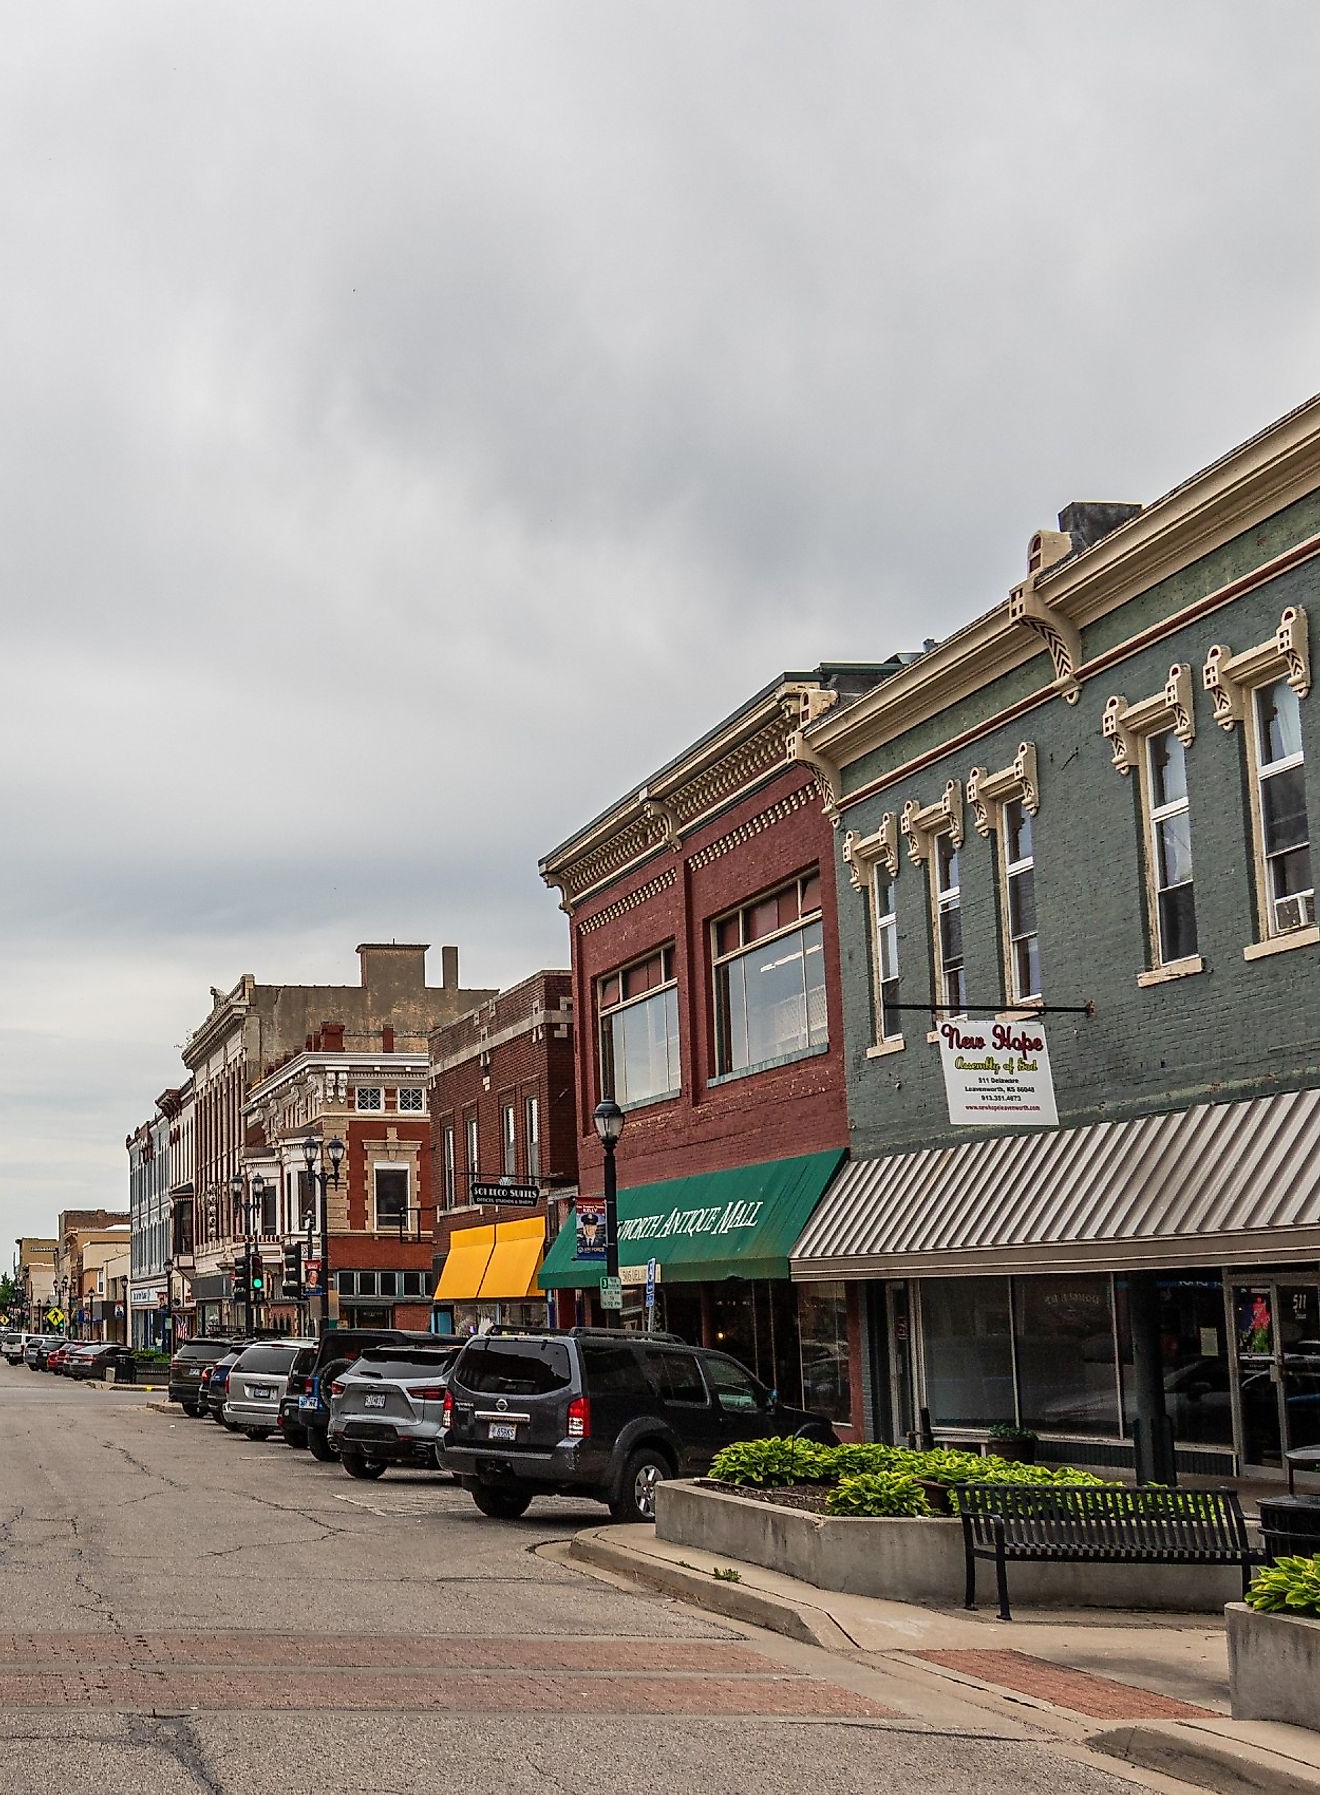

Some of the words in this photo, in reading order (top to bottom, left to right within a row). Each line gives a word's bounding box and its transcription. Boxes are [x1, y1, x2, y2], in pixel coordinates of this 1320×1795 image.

[941, 1023, 986, 1049] New
[992, 1023, 1044, 1060] Hope
[954, 1055, 1001, 1075] Assembly
[1002, 1056, 1015, 1075] of
[1017, 1056, 1038, 1072] God
[654, 1207, 722, 1237] ANTIQUE
[711, 1200, 764, 1234] MALL
[1292, 1294, 1307, 1310] 511
